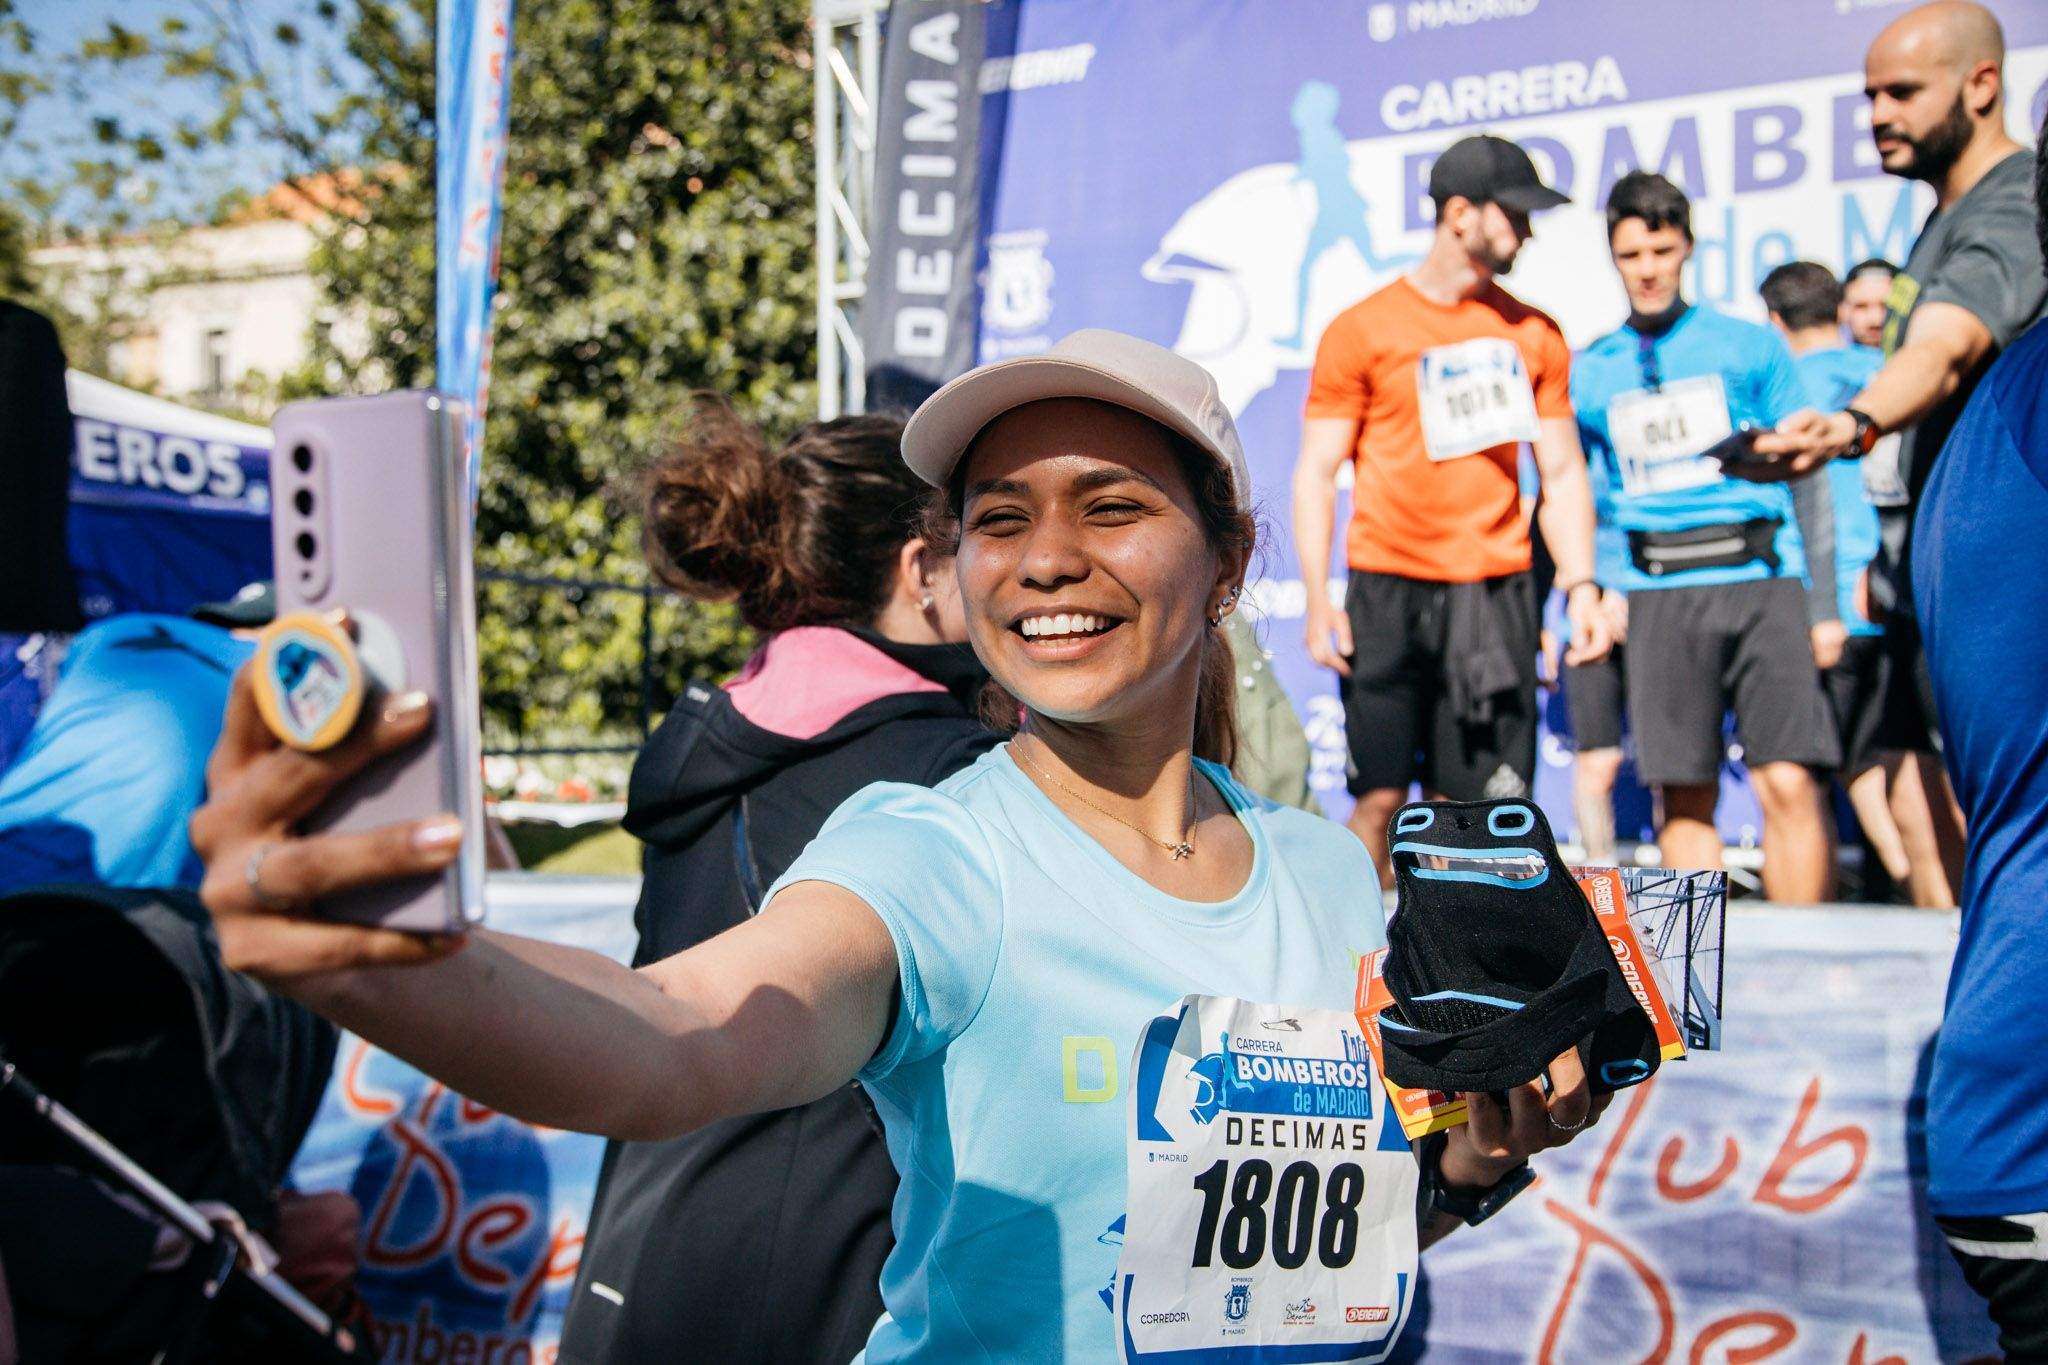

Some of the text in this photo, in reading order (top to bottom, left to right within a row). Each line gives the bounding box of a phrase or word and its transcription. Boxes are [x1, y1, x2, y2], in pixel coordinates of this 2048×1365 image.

[1380, 55, 1628, 131] CARRERA
[893, 12, 960, 357] DECIMA
[79, 419, 246, 499] EROS
[1236, 1037, 1284, 1053] CARRERA
[1236, 1055, 1368, 1089] BOMBEROS
[1294, 1086, 1370, 1117] de MADRID
[1158, 1153, 1188, 1163] MADRID
[1226, 1117, 1366, 1151] DECIMAS
[1587, 1076, 1869, 1214] lub
[1191, 1158, 1365, 1270] 1808
